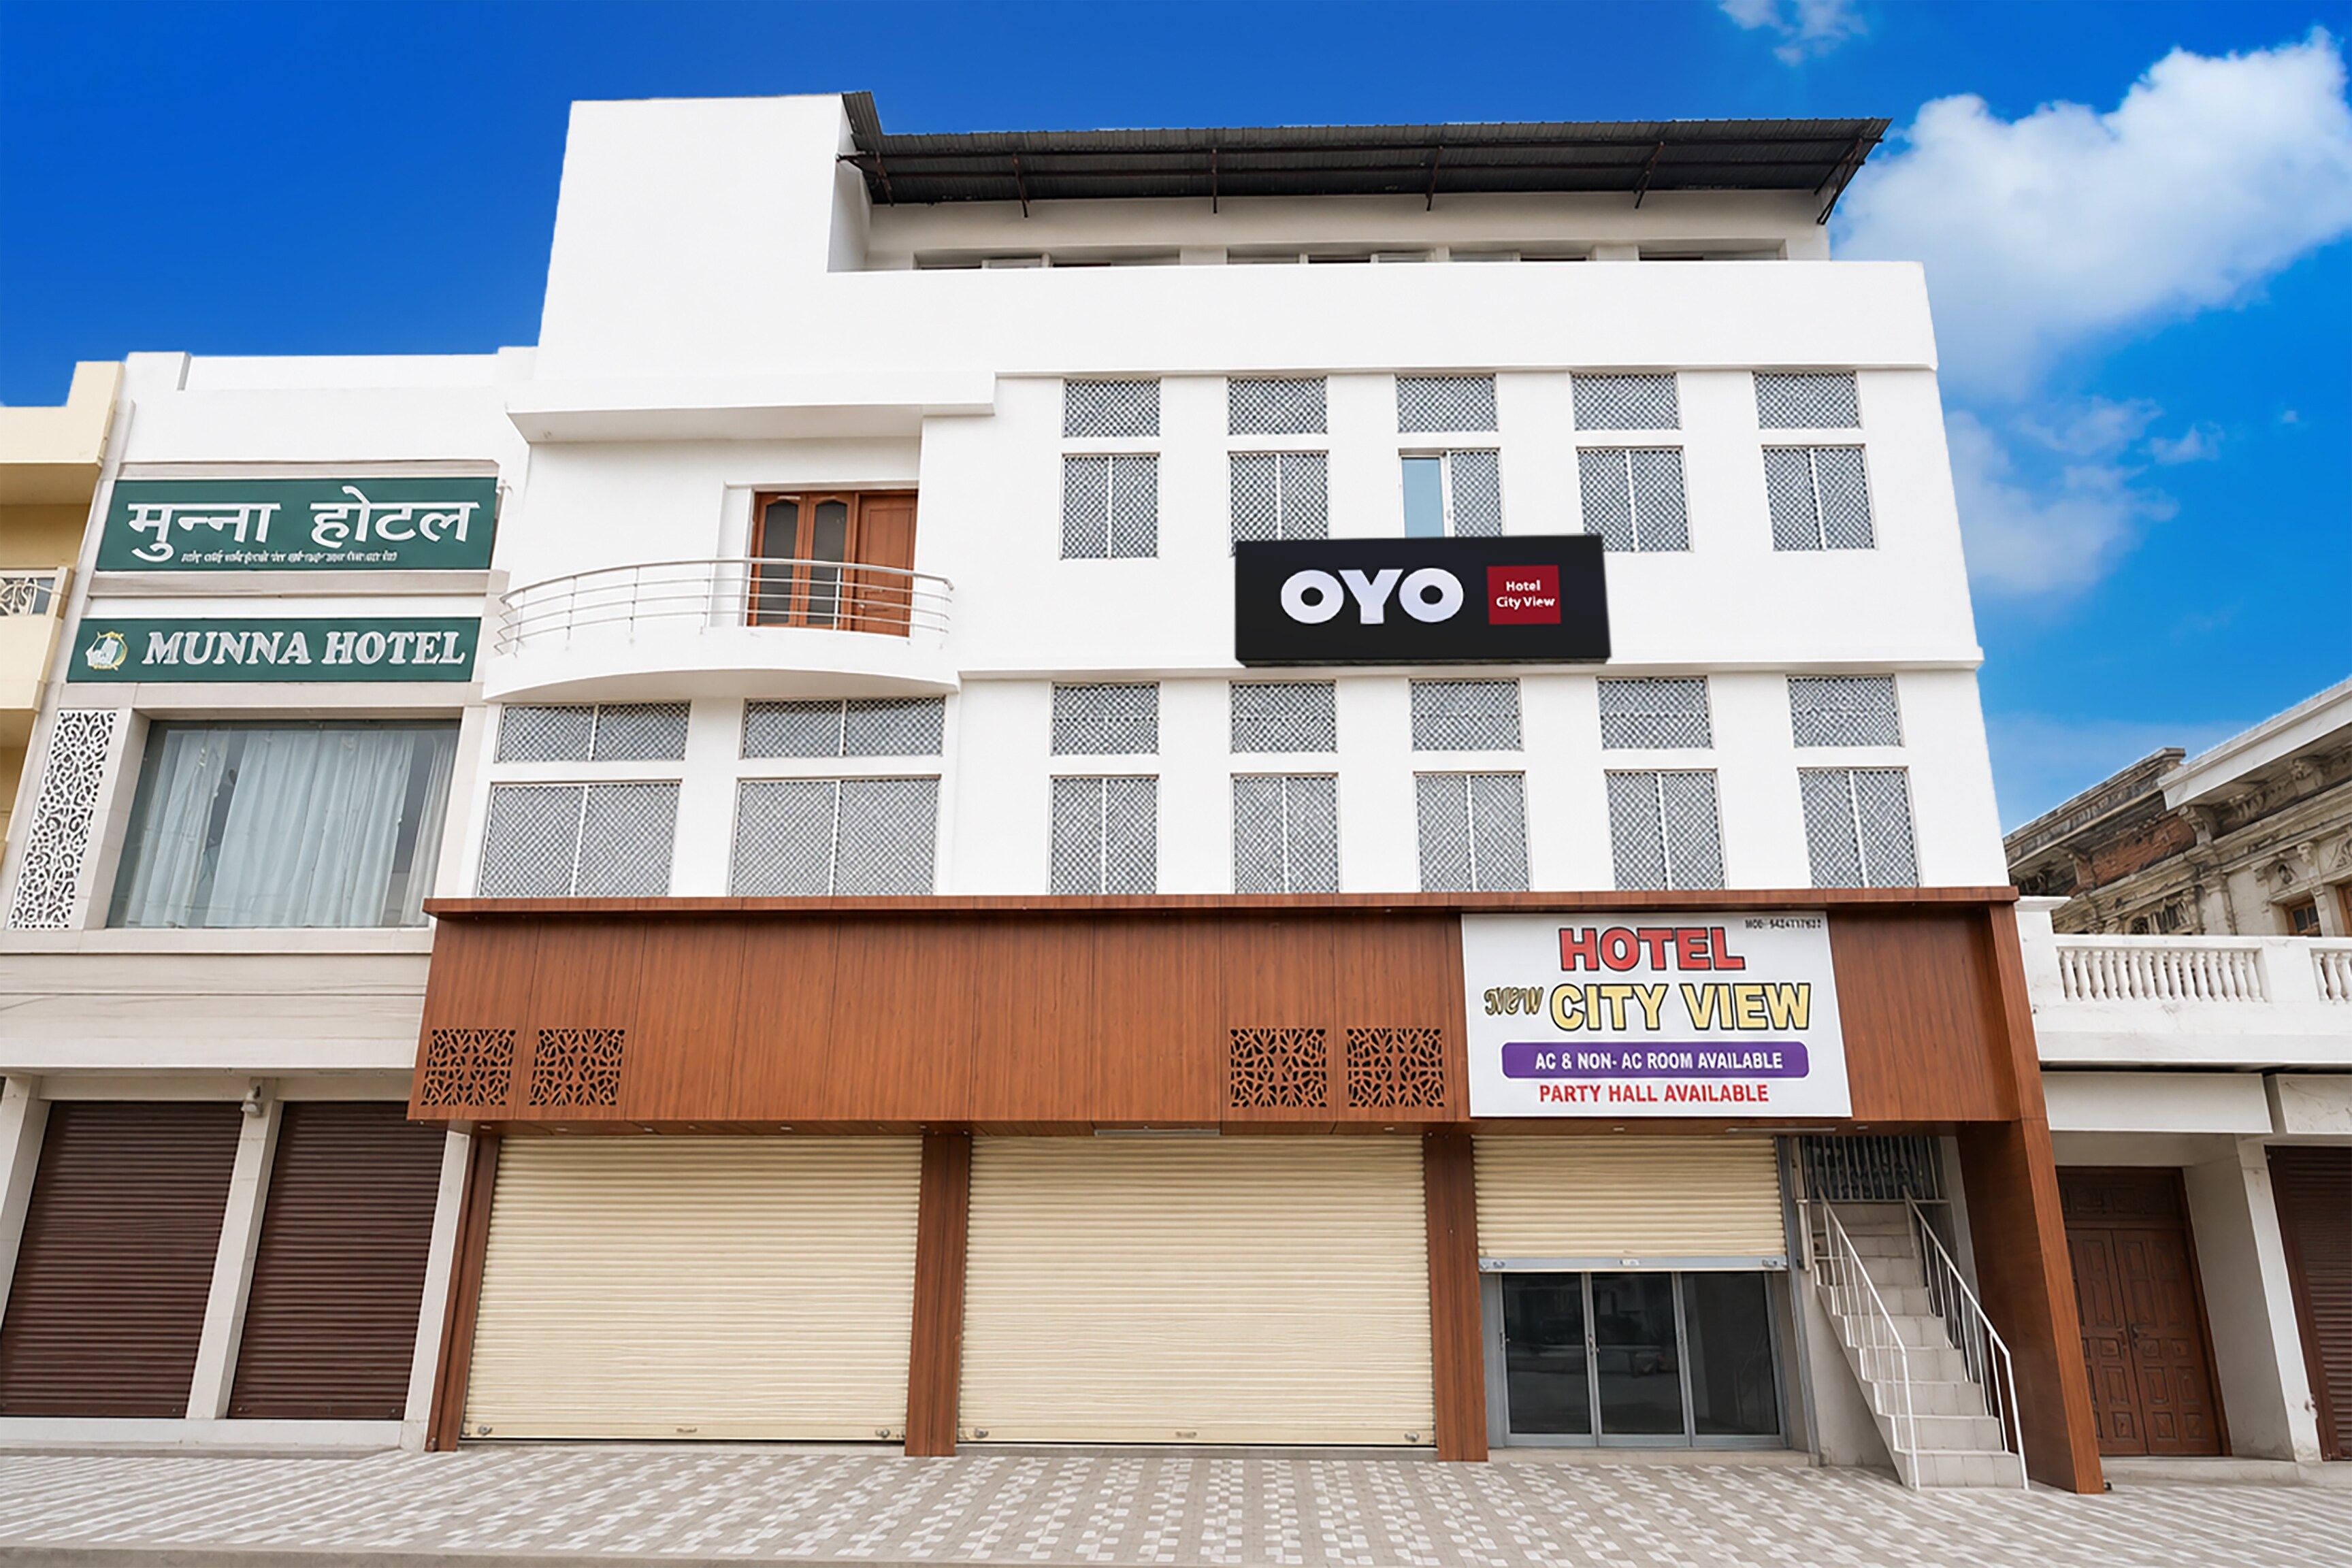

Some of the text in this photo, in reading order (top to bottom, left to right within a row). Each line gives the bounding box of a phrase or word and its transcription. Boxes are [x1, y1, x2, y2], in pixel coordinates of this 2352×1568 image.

[127, 485, 480, 562] मुन्ना होटल
[1281, 568, 1464, 624] OYO
[1506, 579, 1541, 591] Hotel
[1496, 595, 1556, 610] City View
[142, 631, 466, 665] MUNNA HOTEL
[1558, 926, 1746, 971] HOTEL
[1550, 983, 1669, 1032] CITY
[1678, 982, 1812, 1031] VIEW
[1535, 1052, 1556, 1070] AC
[1561, 1052, 1572, 1070] &
[1621, 1052, 1642, 1069] AC
[1647, 1052, 1693, 1069] ROOM
[1697, 1052, 1783, 1069] AVAILABLE
[1539, 1083, 1769, 1102] PARTY HALL AVAILABLE
